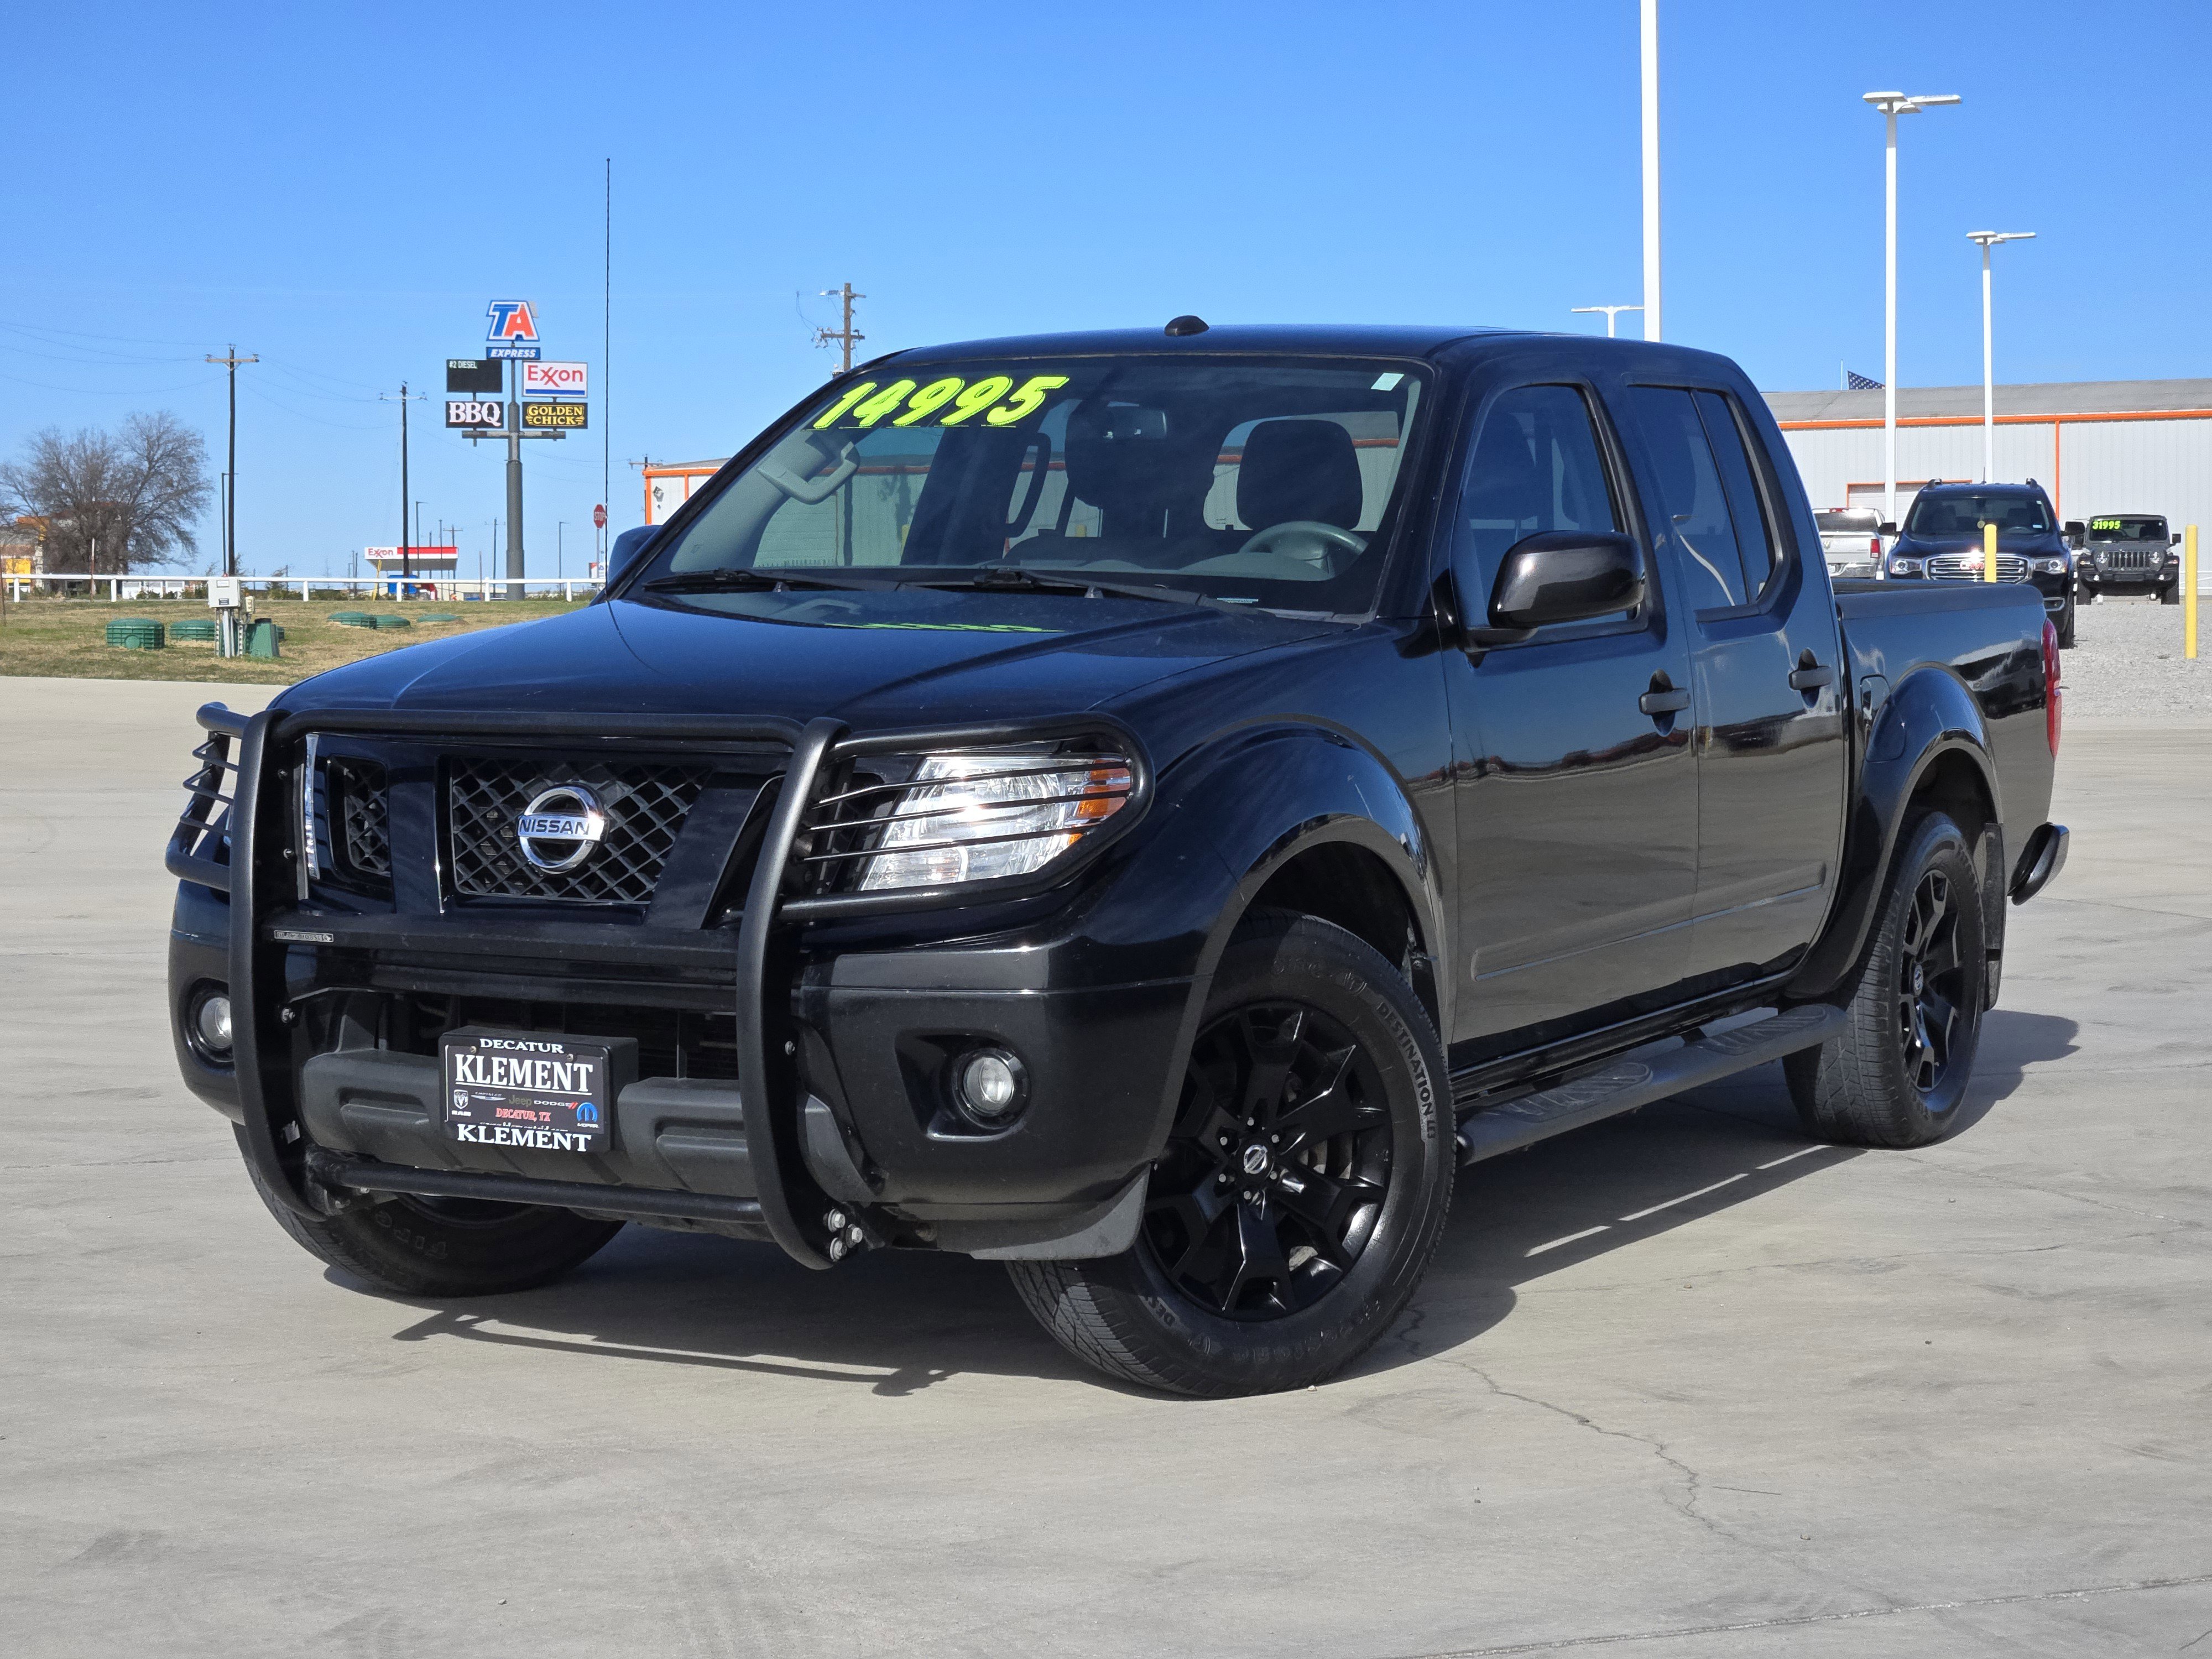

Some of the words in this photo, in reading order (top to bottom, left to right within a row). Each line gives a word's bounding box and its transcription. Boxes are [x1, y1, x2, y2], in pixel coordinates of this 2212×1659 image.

[491, 302, 536, 338] TA
[491, 348, 536, 358] EXPRESS
[458, 361, 478, 369] DIESEL
[528, 365, 583, 387] Exxon
[813, 376, 1070, 429] 14995
[449, 402, 501, 426] BBQ
[528, 406, 583, 415] GOLDEN
[533, 416, 576, 425] CHICK
[2092, 520, 2121, 530] 31995
[368, 548, 394, 558] Exxon
[1959, 560, 1985, 570] GM
[519, 819, 590, 836] NISSAN
[480, 1038, 565, 1054] DECATUR
[1376, 1001, 1434, 1117] DESTINATION
[455, 1053, 593, 1092] KLEMENT
[508, 1094, 532, 1108] Jeep
[495, 1108, 537, 1122] DECATUR,
[539, 1112, 552, 1122] TX
[457, 1123, 592, 1152] KLEMENT
